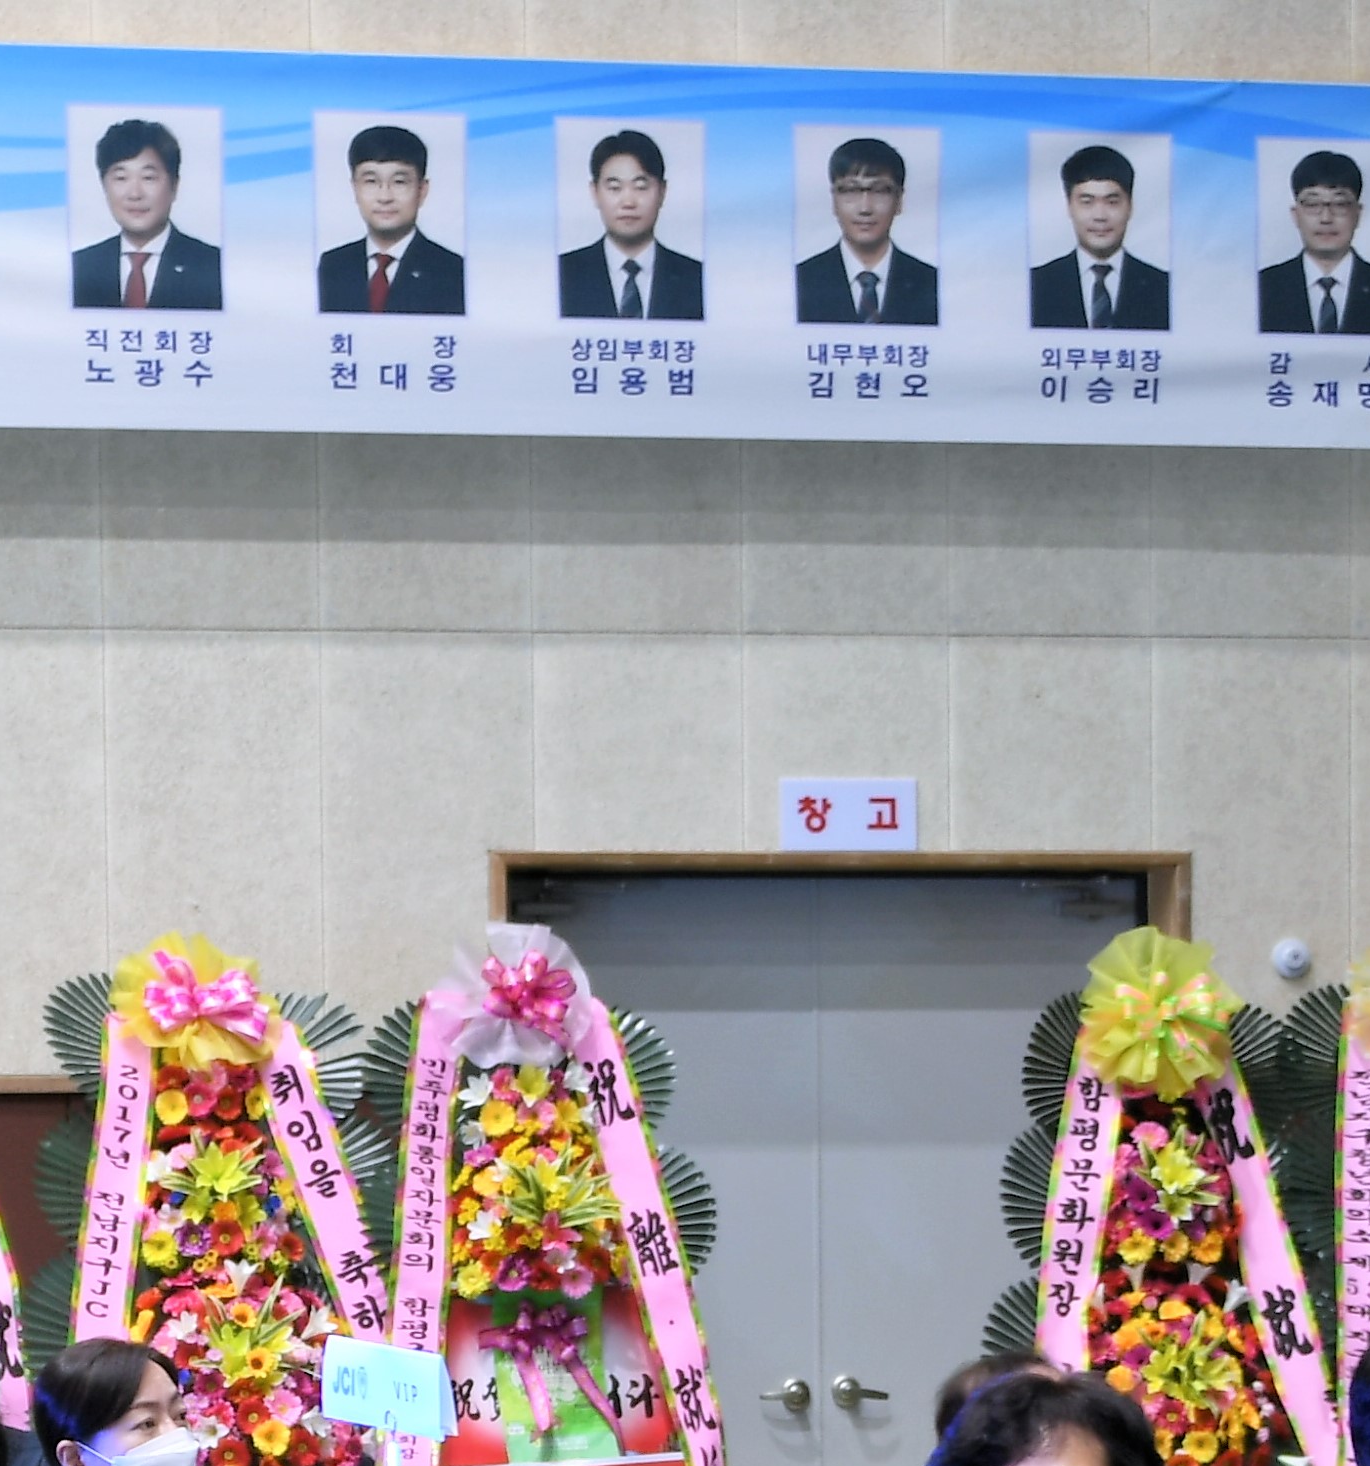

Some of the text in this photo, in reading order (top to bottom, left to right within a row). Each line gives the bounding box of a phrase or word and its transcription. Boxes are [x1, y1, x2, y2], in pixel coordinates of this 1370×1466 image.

[85, 327, 213, 355] 직전회장
[571, 338, 696, 363] 상임부회장
[807, 343, 930, 368] 내무부회장
[85, 358, 214, 387] 노광수
[1040, 347, 1162, 373] 외무부회장
[329, 362, 457, 392] 천대웅
[572, 367, 695, 397] 임용범
[807, 372, 929, 400] 김현오
[1040, 375, 1159, 404] 이승리
[797, 796, 899, 834] 창고
[104, 1065, 139, 1170] 2017년
[270, 1065, 340, 1197] 취임을
[1048, 1077, 1108, 1317] 함평문화원장
[397, 1298, 434, 1350] 함평
[333, 1366, 418, 1402] JCI VIP
